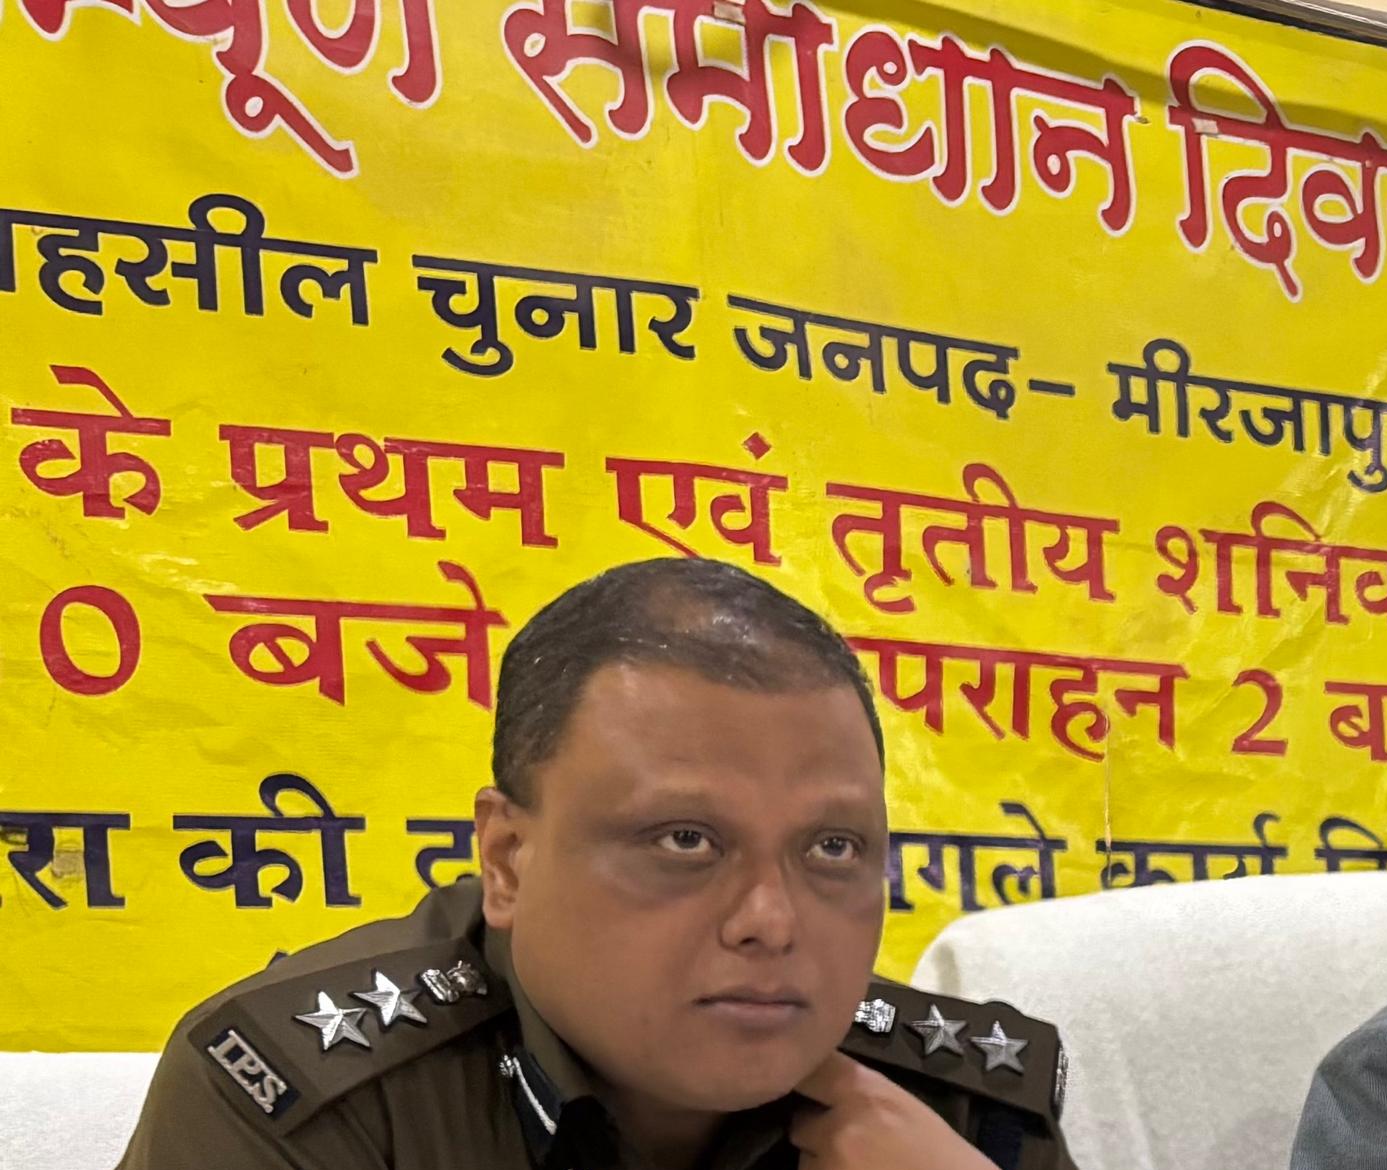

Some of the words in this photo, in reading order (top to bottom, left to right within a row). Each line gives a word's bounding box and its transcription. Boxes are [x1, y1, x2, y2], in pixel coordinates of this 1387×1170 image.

[503, 0, 1137, 236] समाधान
[411, 254, 699, 377] चुनार
[11, 364, 171, 520] के
[219, 423, 565, 548] प्रथम
[606, 432, 788, 565] एवं
[825, 463, 1119, 613] तृतीय
[203, 560, 509, 710] बजे
[845, 636, 1191, 763] पराहन
[1231, 668, 1288, 755] 2
[172, 772, 366, 908] की
[886, 802, 1067, 912] गले
[207, 1029, 288, 1113] IPS
